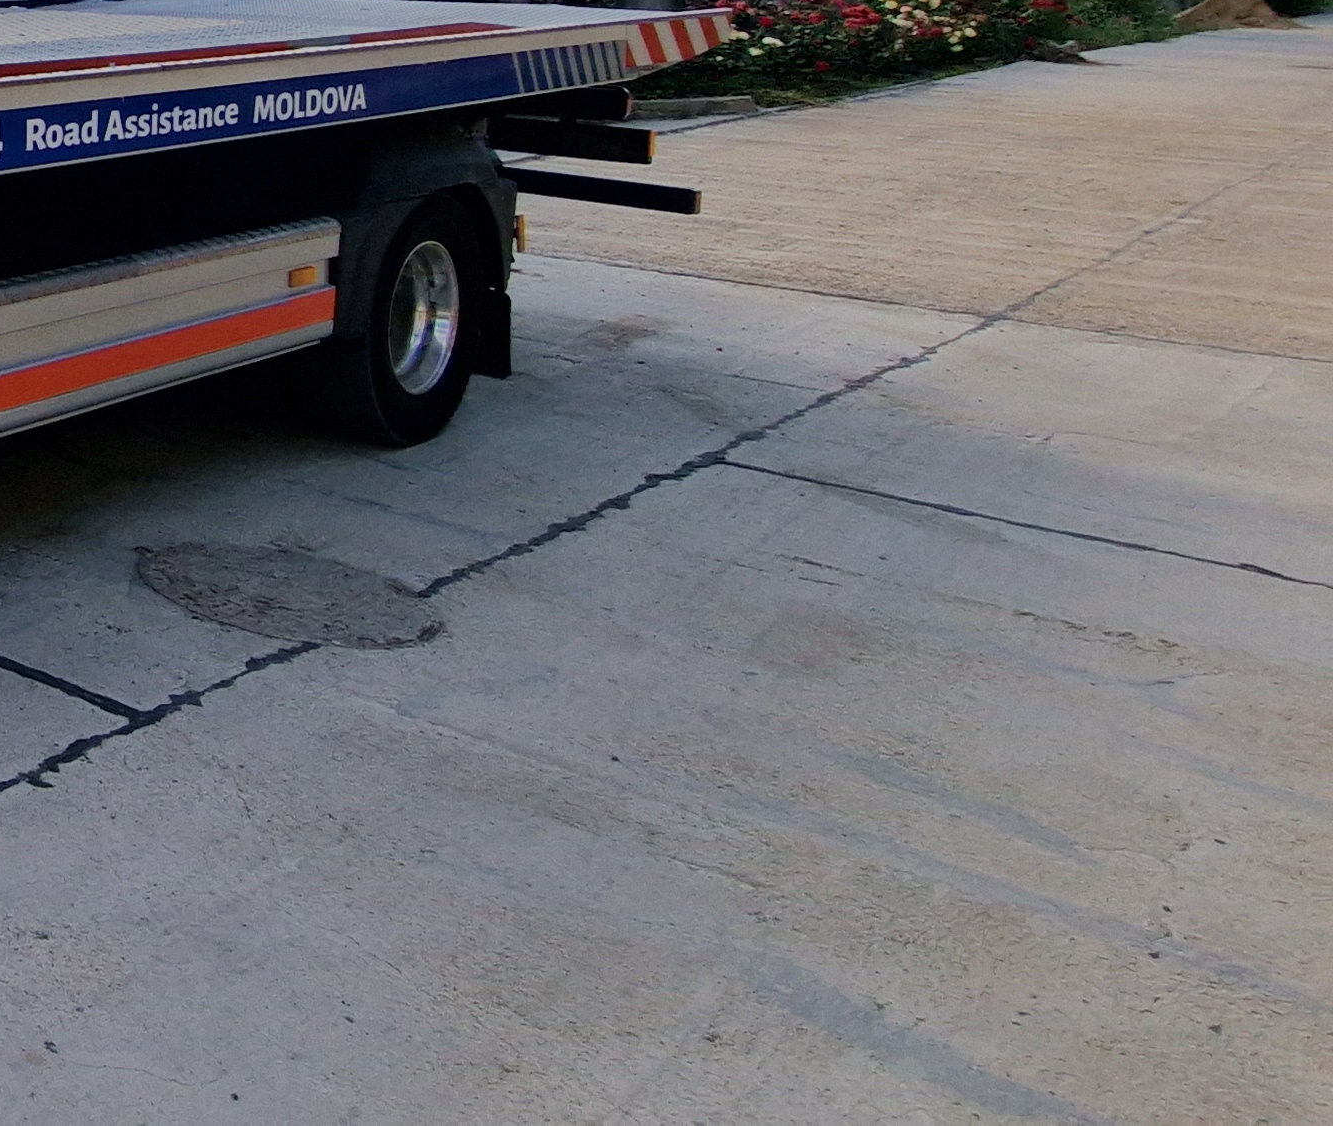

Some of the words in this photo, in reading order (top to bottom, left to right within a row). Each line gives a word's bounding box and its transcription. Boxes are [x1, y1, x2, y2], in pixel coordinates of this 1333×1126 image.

[24, 108, 100, 153] Road
[103, 87, 240, 141] Assistance
[252, 82, 367, 125] MOLDOVA
